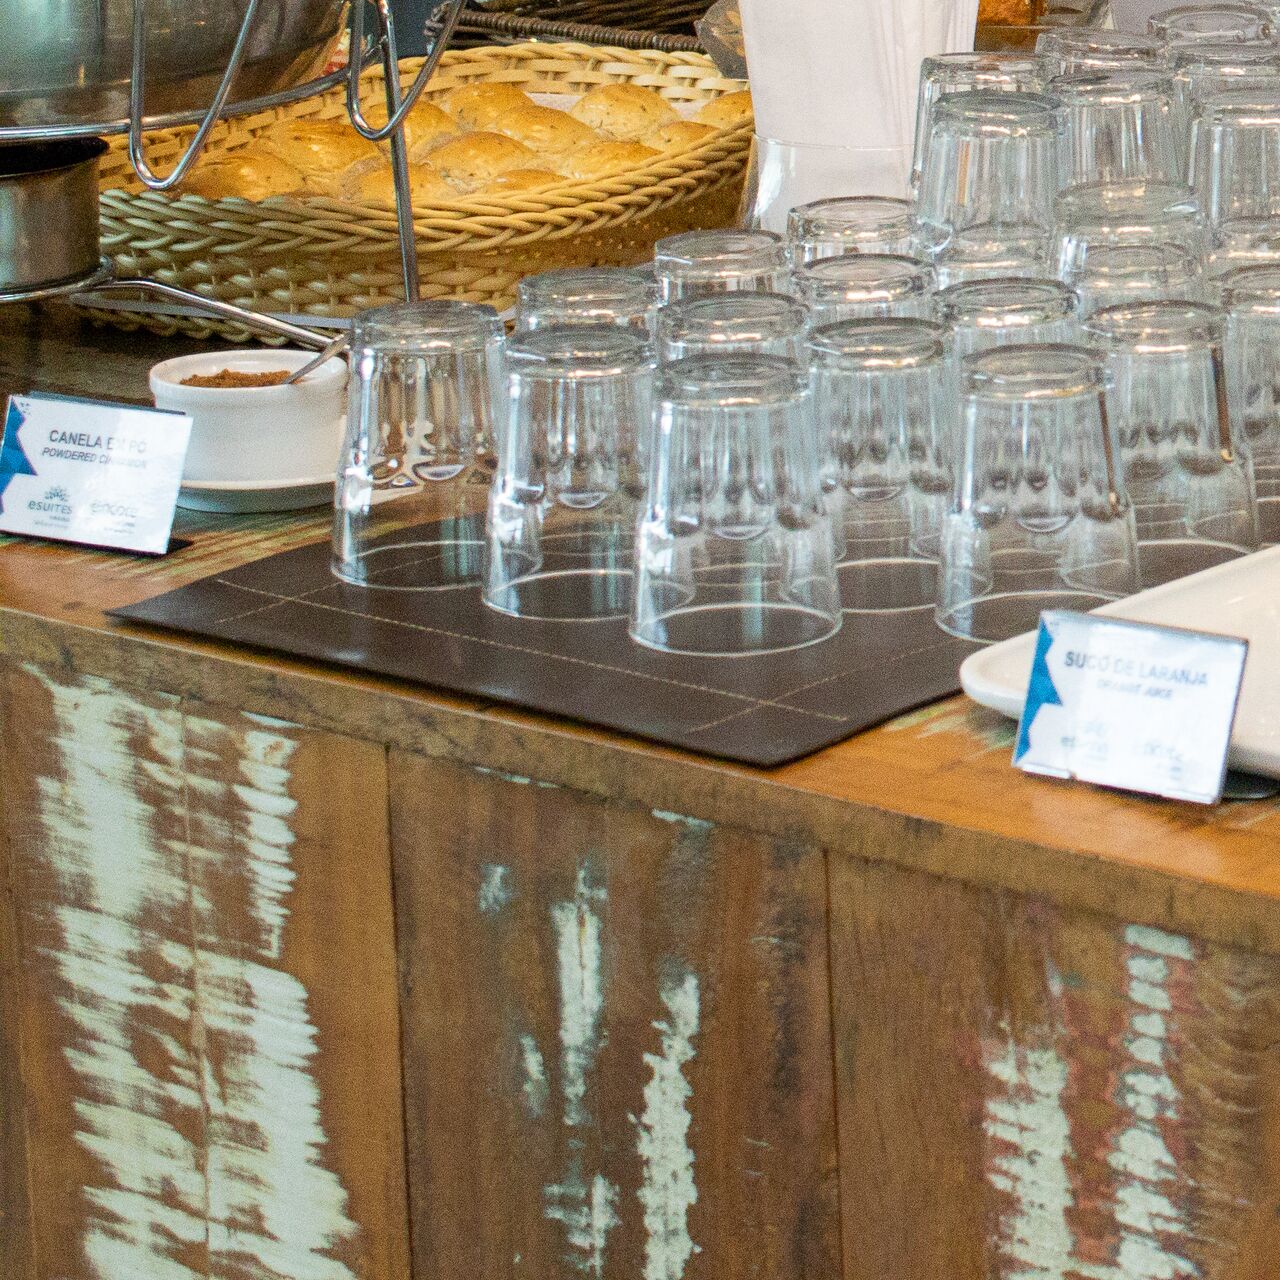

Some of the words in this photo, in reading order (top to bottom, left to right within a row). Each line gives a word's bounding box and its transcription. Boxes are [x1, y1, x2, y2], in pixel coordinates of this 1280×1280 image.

[49, 429, 102, 448] CANELA
[42, 447, 97, 462] POWDERED
[1064, 650, 1111, 672] SUCO
[1114, 658, 1135, 676] DE
[1139, 661, 1209, 687] LARANJA
